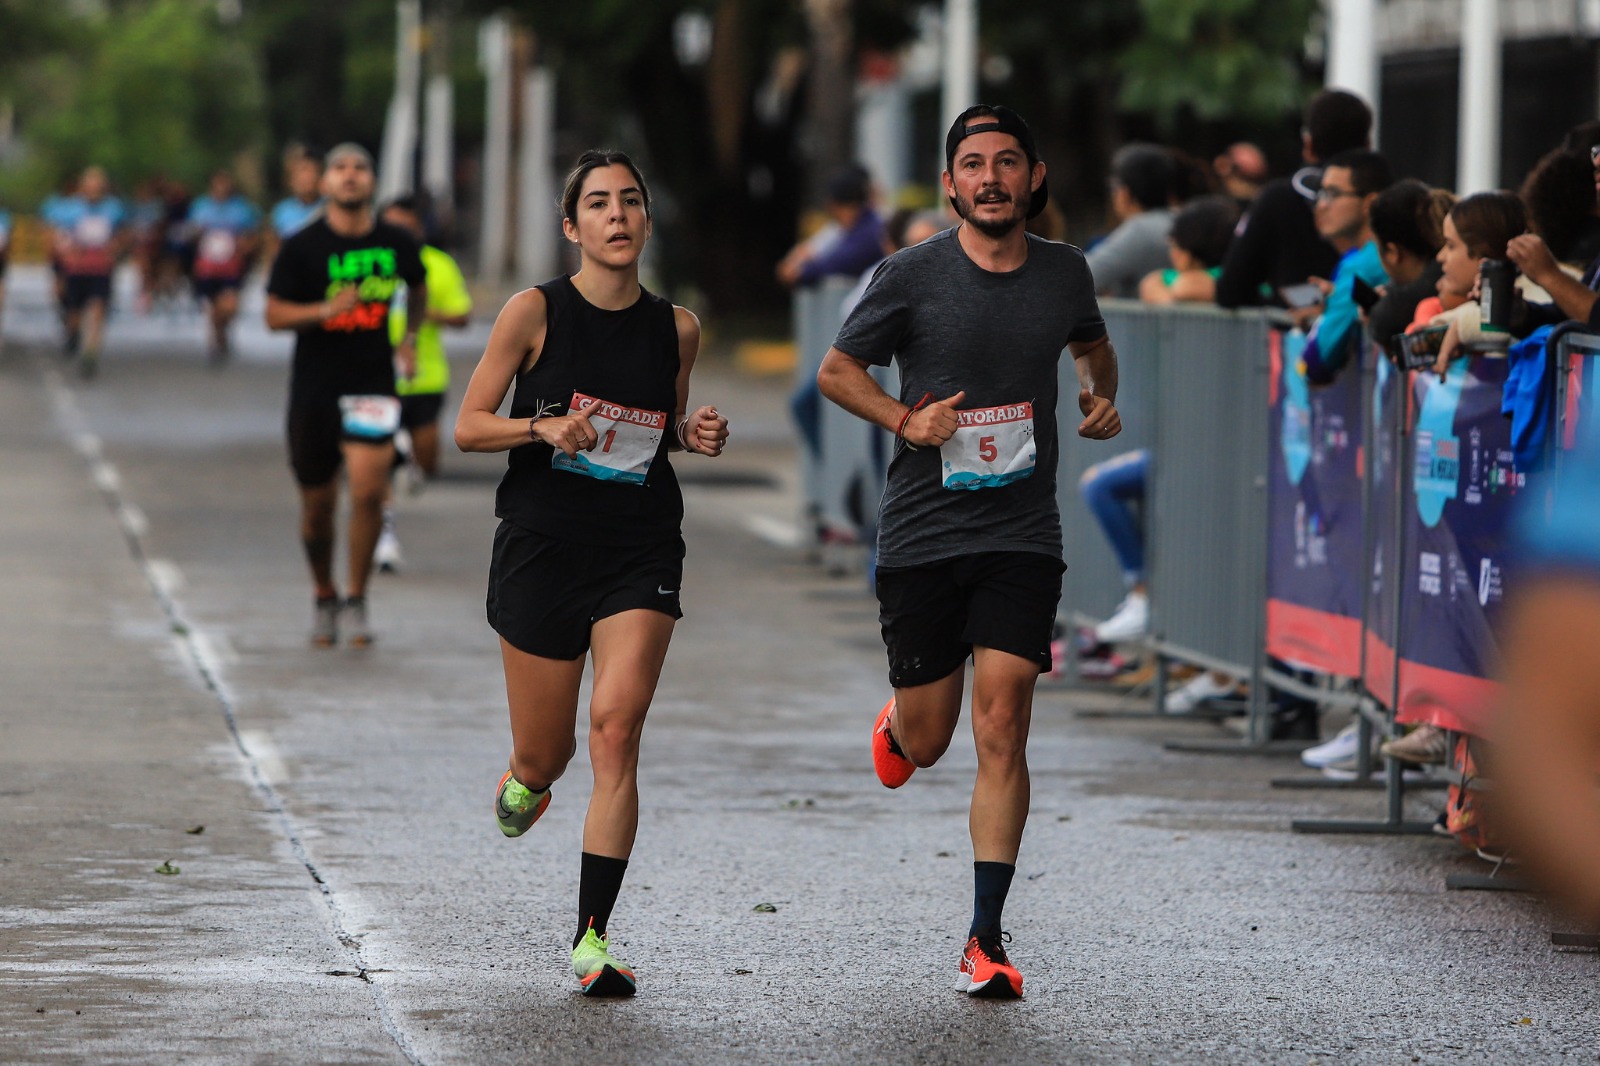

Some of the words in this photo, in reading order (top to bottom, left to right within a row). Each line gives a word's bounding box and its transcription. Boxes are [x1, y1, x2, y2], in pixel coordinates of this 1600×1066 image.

[579, 398, 661, 426] GTORADE
[957, 405, 1026, 425] ATORADE
[602, 429, 617, 453] 1
[979, 436, 998, 462] 5
